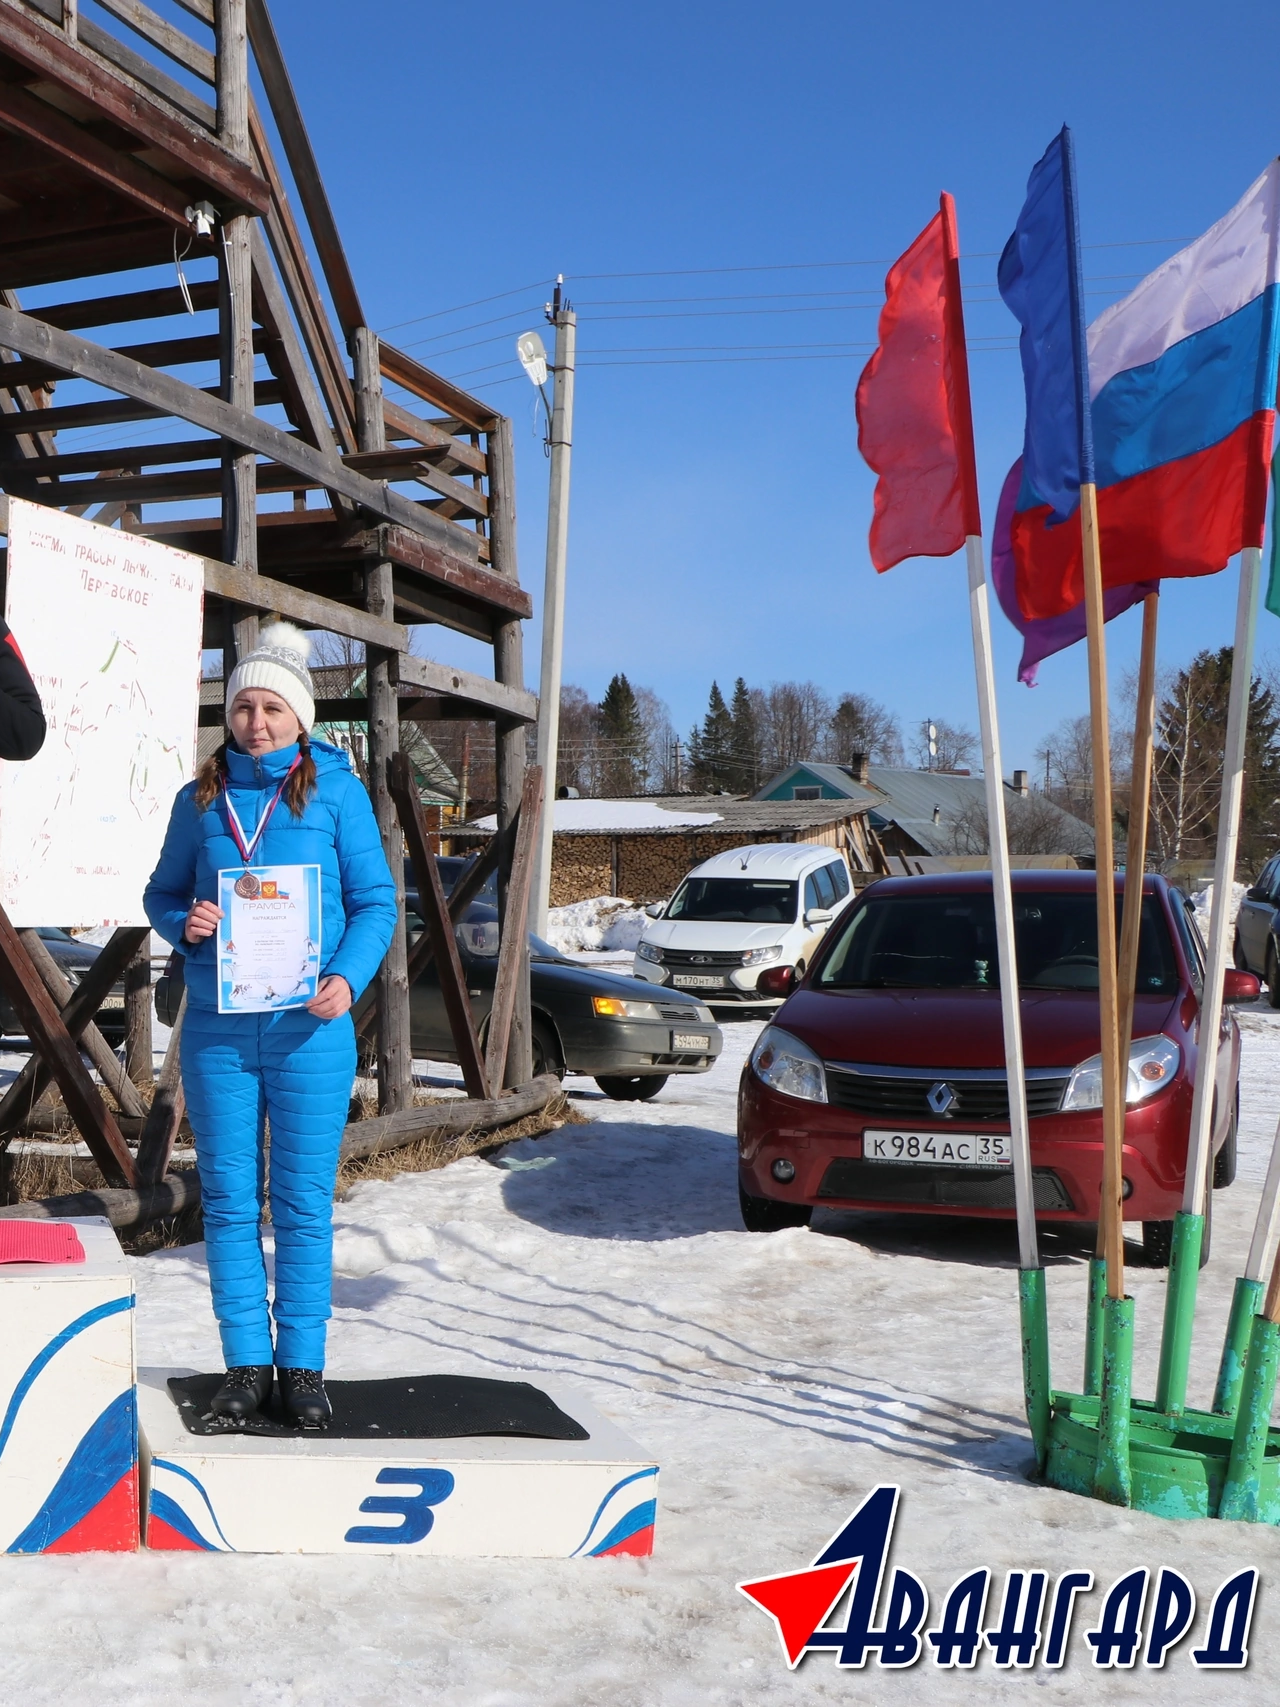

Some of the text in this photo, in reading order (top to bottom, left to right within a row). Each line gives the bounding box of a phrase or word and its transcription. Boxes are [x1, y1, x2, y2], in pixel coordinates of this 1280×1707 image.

[242, 902, 296, 911] ГРАМОТА
[874, 1136, 1004, 1161] К984АС 35
[978, 1155, 997, 1163] RUS
[343, 1467, 455, 1544] 3
